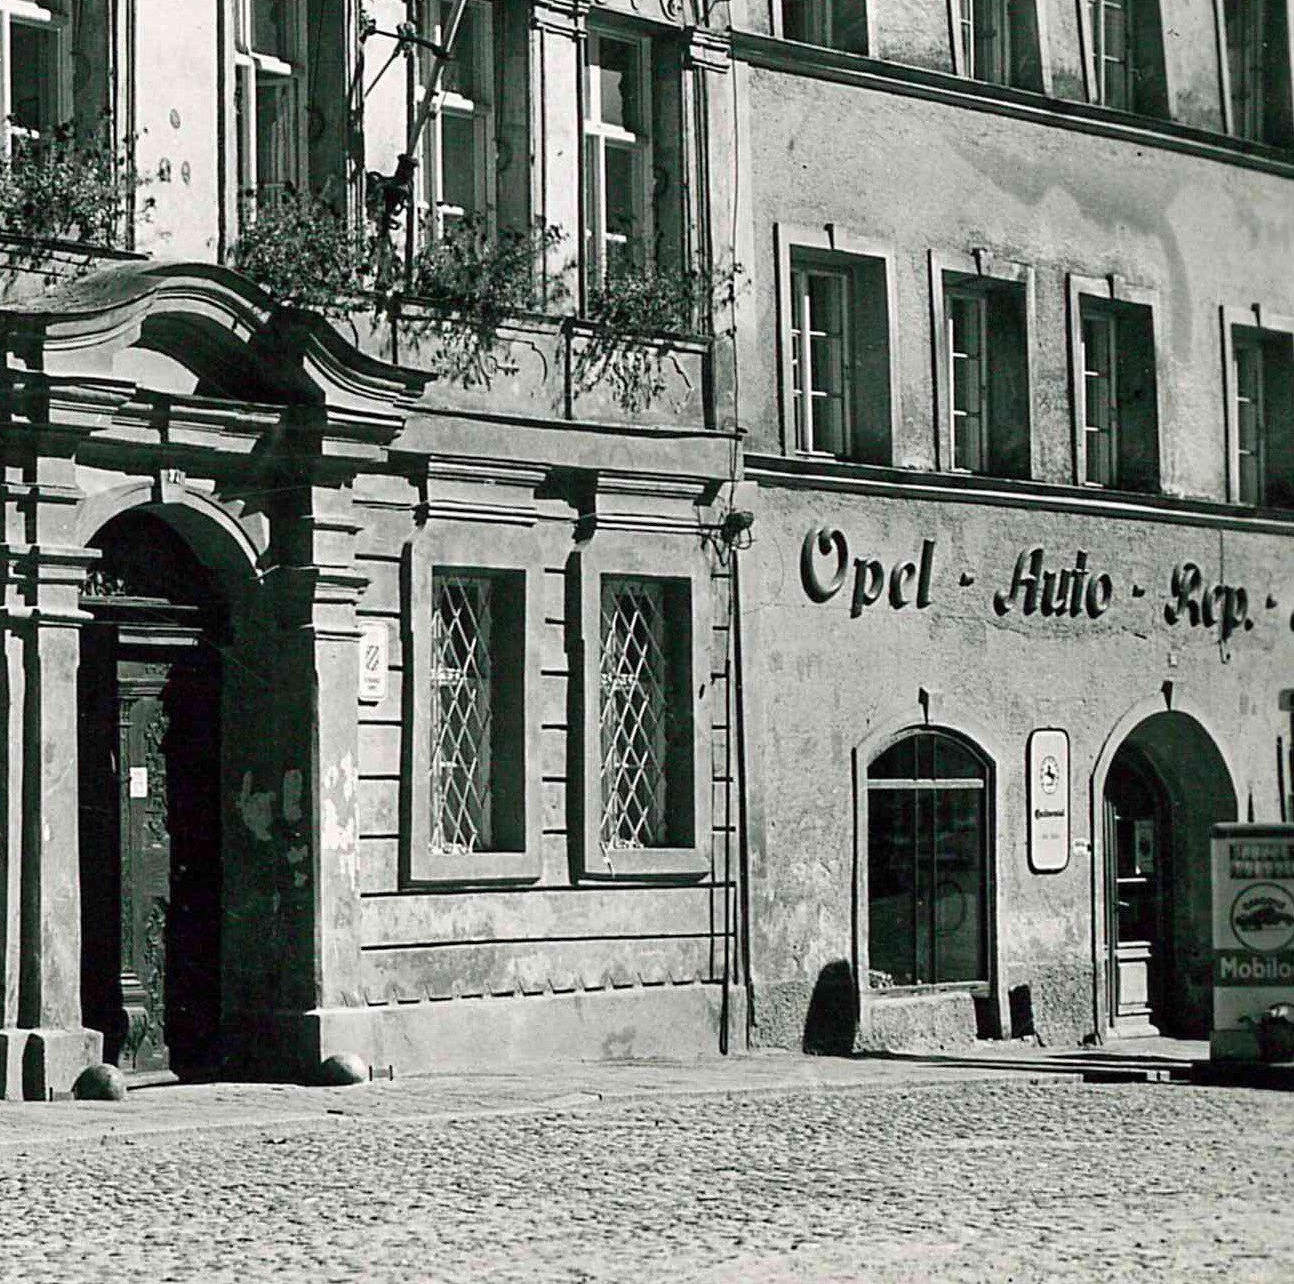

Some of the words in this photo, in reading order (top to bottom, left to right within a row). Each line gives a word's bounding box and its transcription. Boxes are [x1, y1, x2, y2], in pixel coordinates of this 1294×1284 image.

[799, 527, 936, 619] Opel
[993, 546, 1114, 620] Auto
[1163, 561, 1255, 641] Rep.
